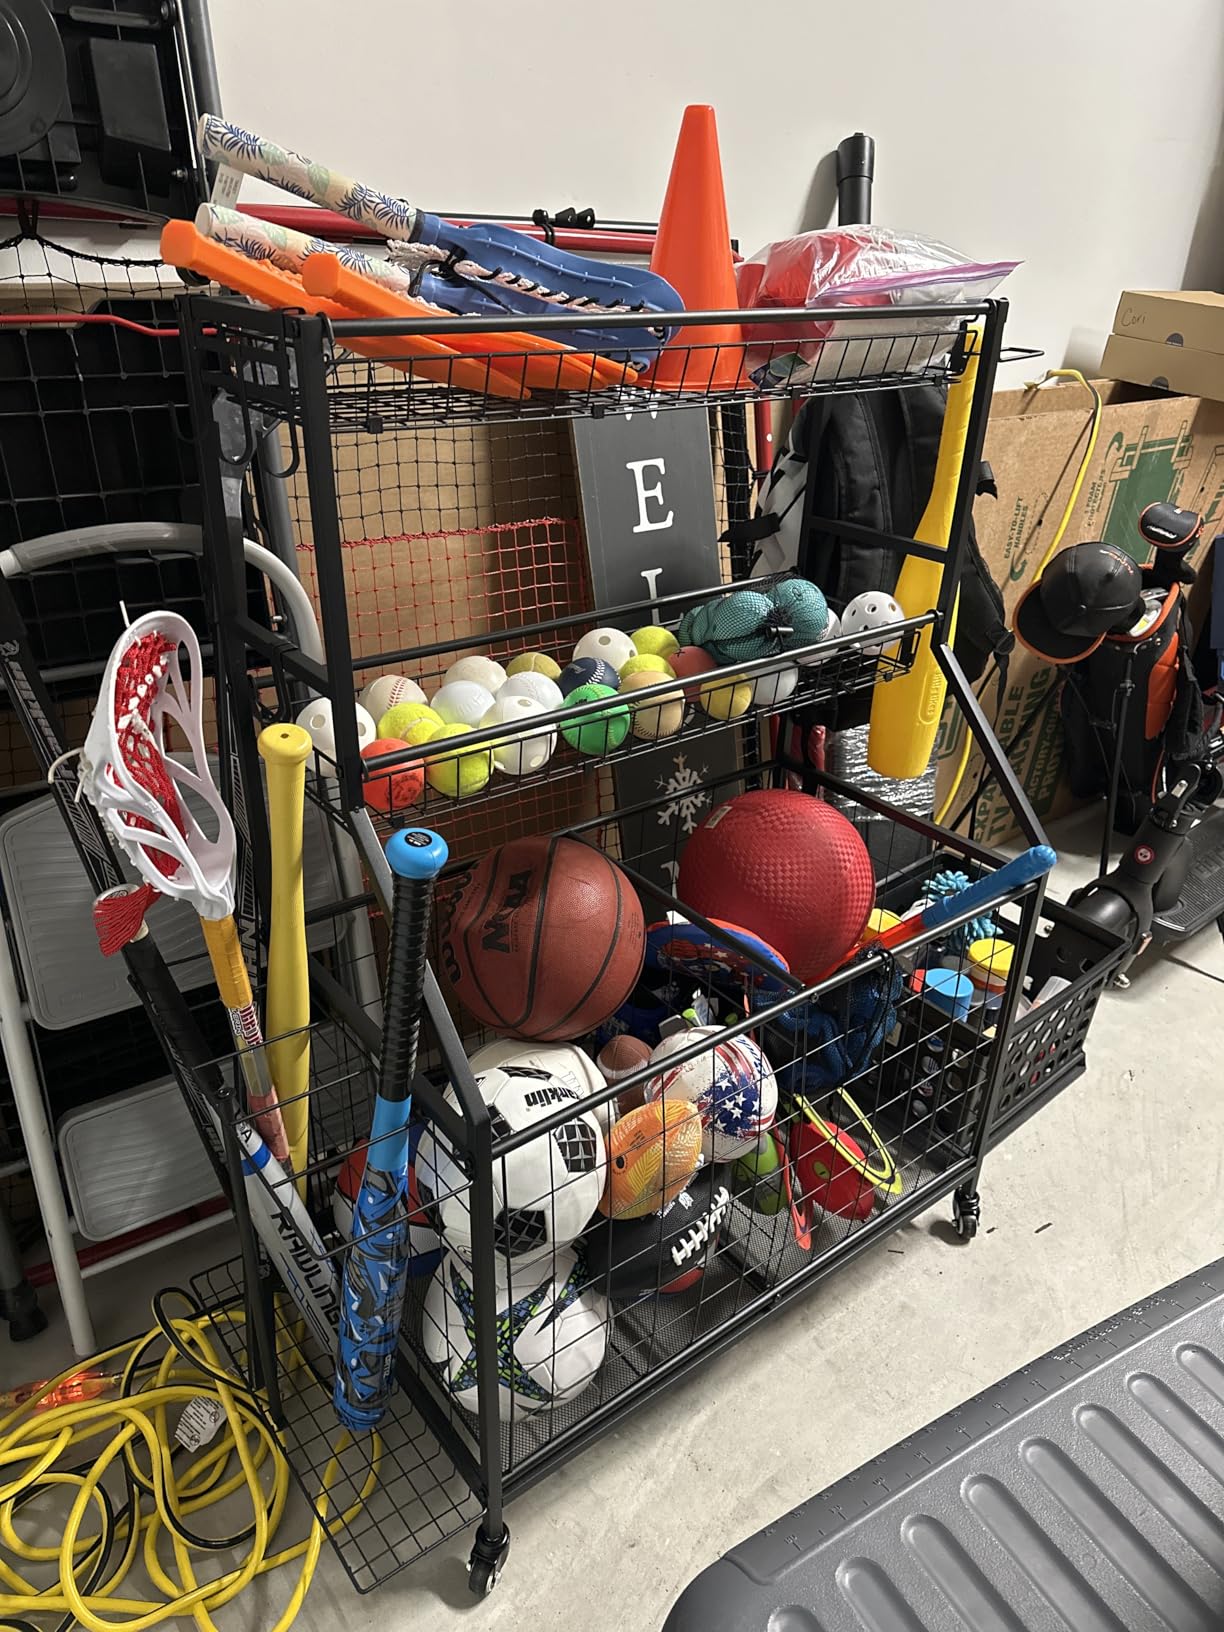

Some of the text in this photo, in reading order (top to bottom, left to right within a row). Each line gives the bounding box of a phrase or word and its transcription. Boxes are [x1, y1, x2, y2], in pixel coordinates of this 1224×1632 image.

[1121, 308, 1146, 327] Cori
[1004, 496, 1024, 559] EASY-TO-LIFT
[1014, 505, 1029, 550] HANDLES
[975, 686, 1025, 843] EXPAABLE
[524, 1087, 580, 1107] anklin
[270, 1211, 339, 1337] RAWLING
